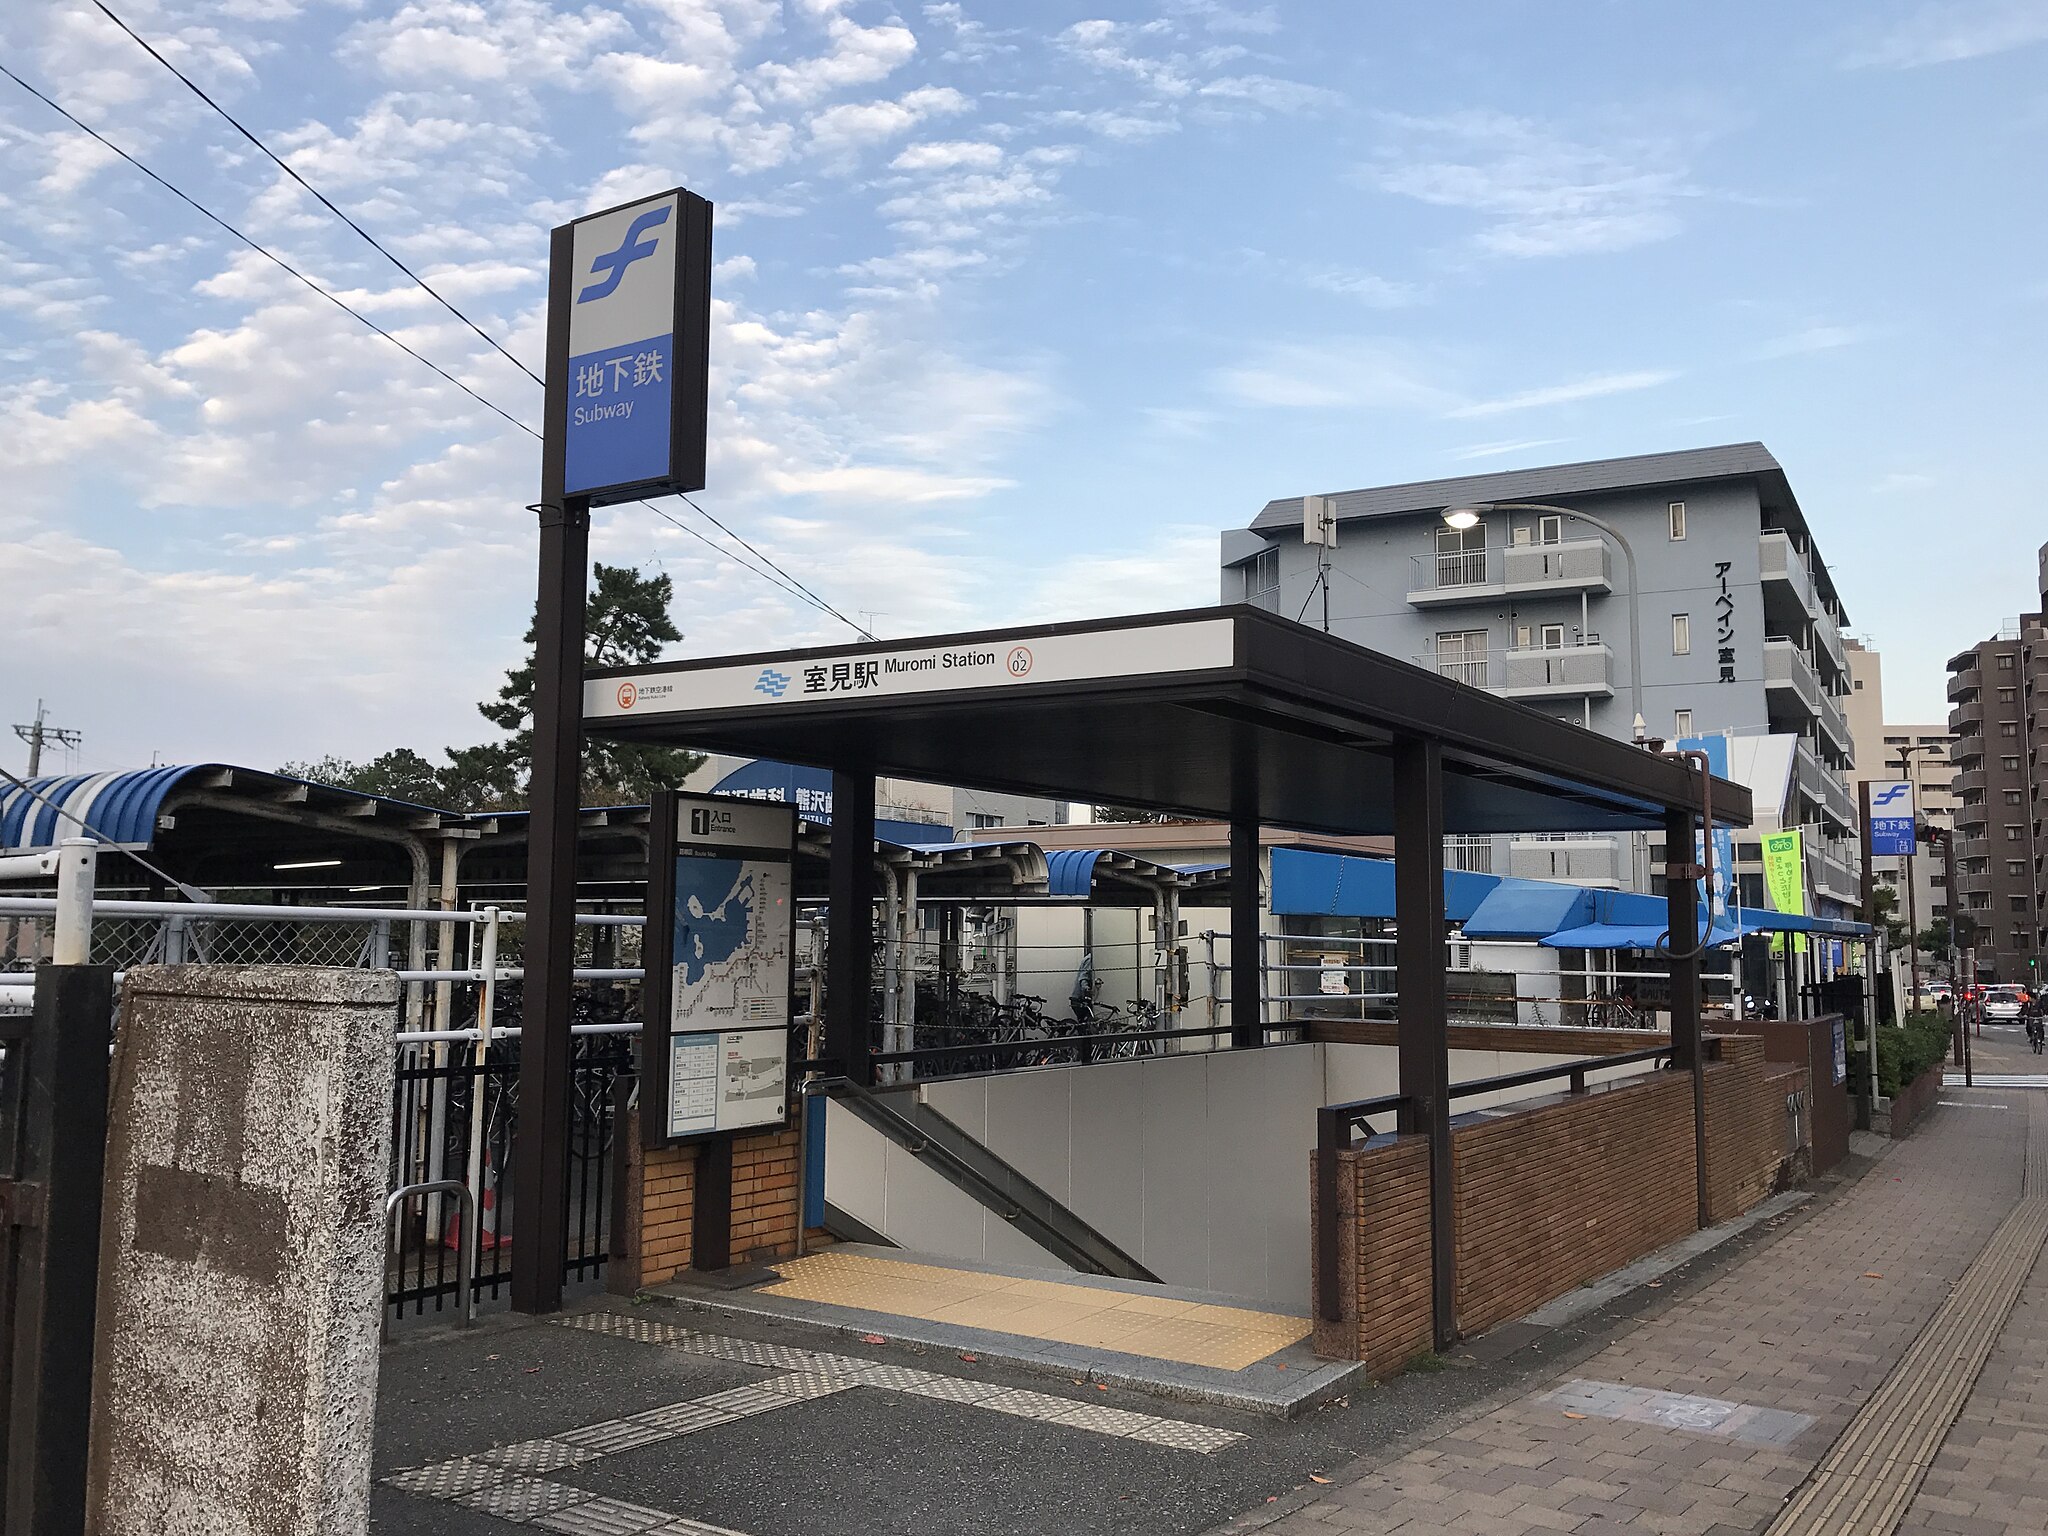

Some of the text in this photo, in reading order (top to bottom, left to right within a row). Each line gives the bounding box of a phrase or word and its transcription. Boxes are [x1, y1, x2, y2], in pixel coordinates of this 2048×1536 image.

[575, 349, 663, 398] 地下鉄
[574, 400, 635, 426] Subway
[884, 650, 995, 674] Muromi Station
[1016, 651, 1022, 659] K
[1012, 659, 1027, 672] 02
[803, 660, 879, 694] 室見駅
[695, 809, 705, 834] 1
[711, 810, 731, 824] 入口
[710, 824, 737, 834] Entrance
[1873, 820, 1911, 831] 地下鉄
[1154, 952, 1162, 967] 7
[990, 962, 997, 973] 8
